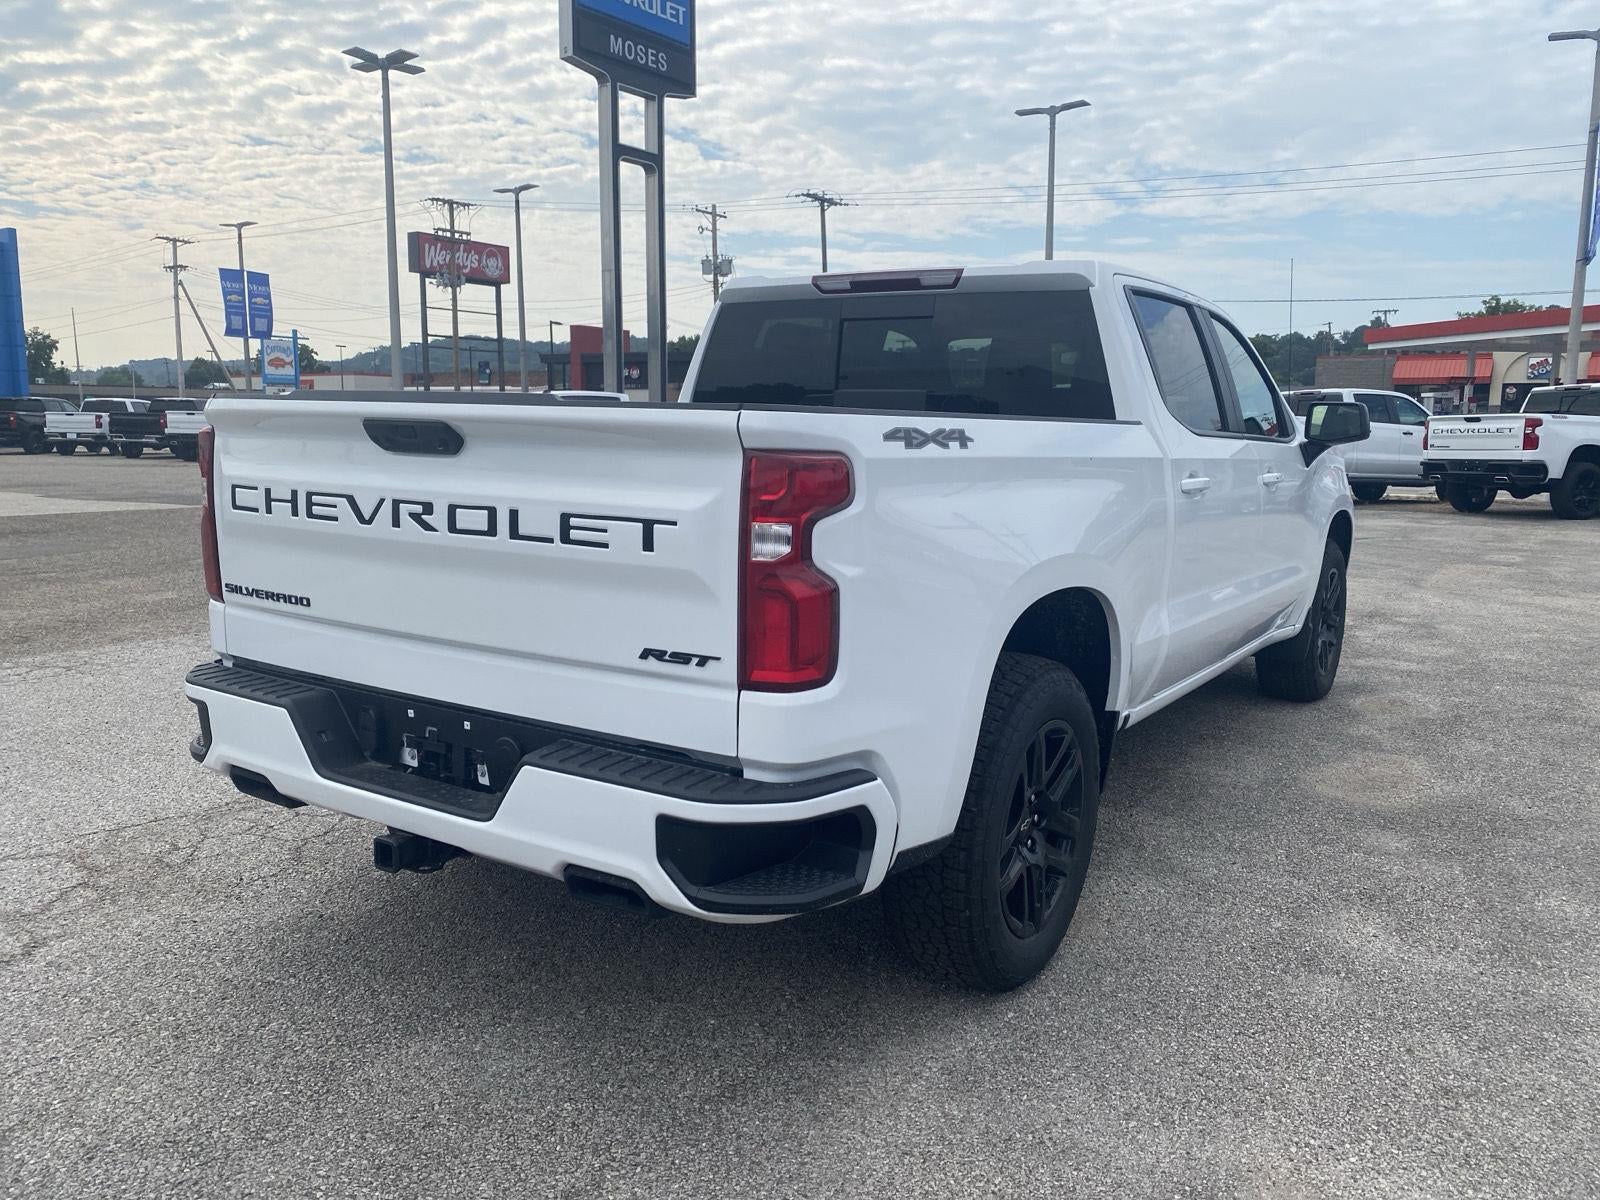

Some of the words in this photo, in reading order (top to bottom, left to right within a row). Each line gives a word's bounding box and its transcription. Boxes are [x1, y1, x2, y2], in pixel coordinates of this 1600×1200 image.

[609, 34, 668, 71] MOSES
[231, 483, 678, 553] CHEVROLET
[224, 582, 311, 608] SILVERADO
[638, 647, 722, 669] RST
